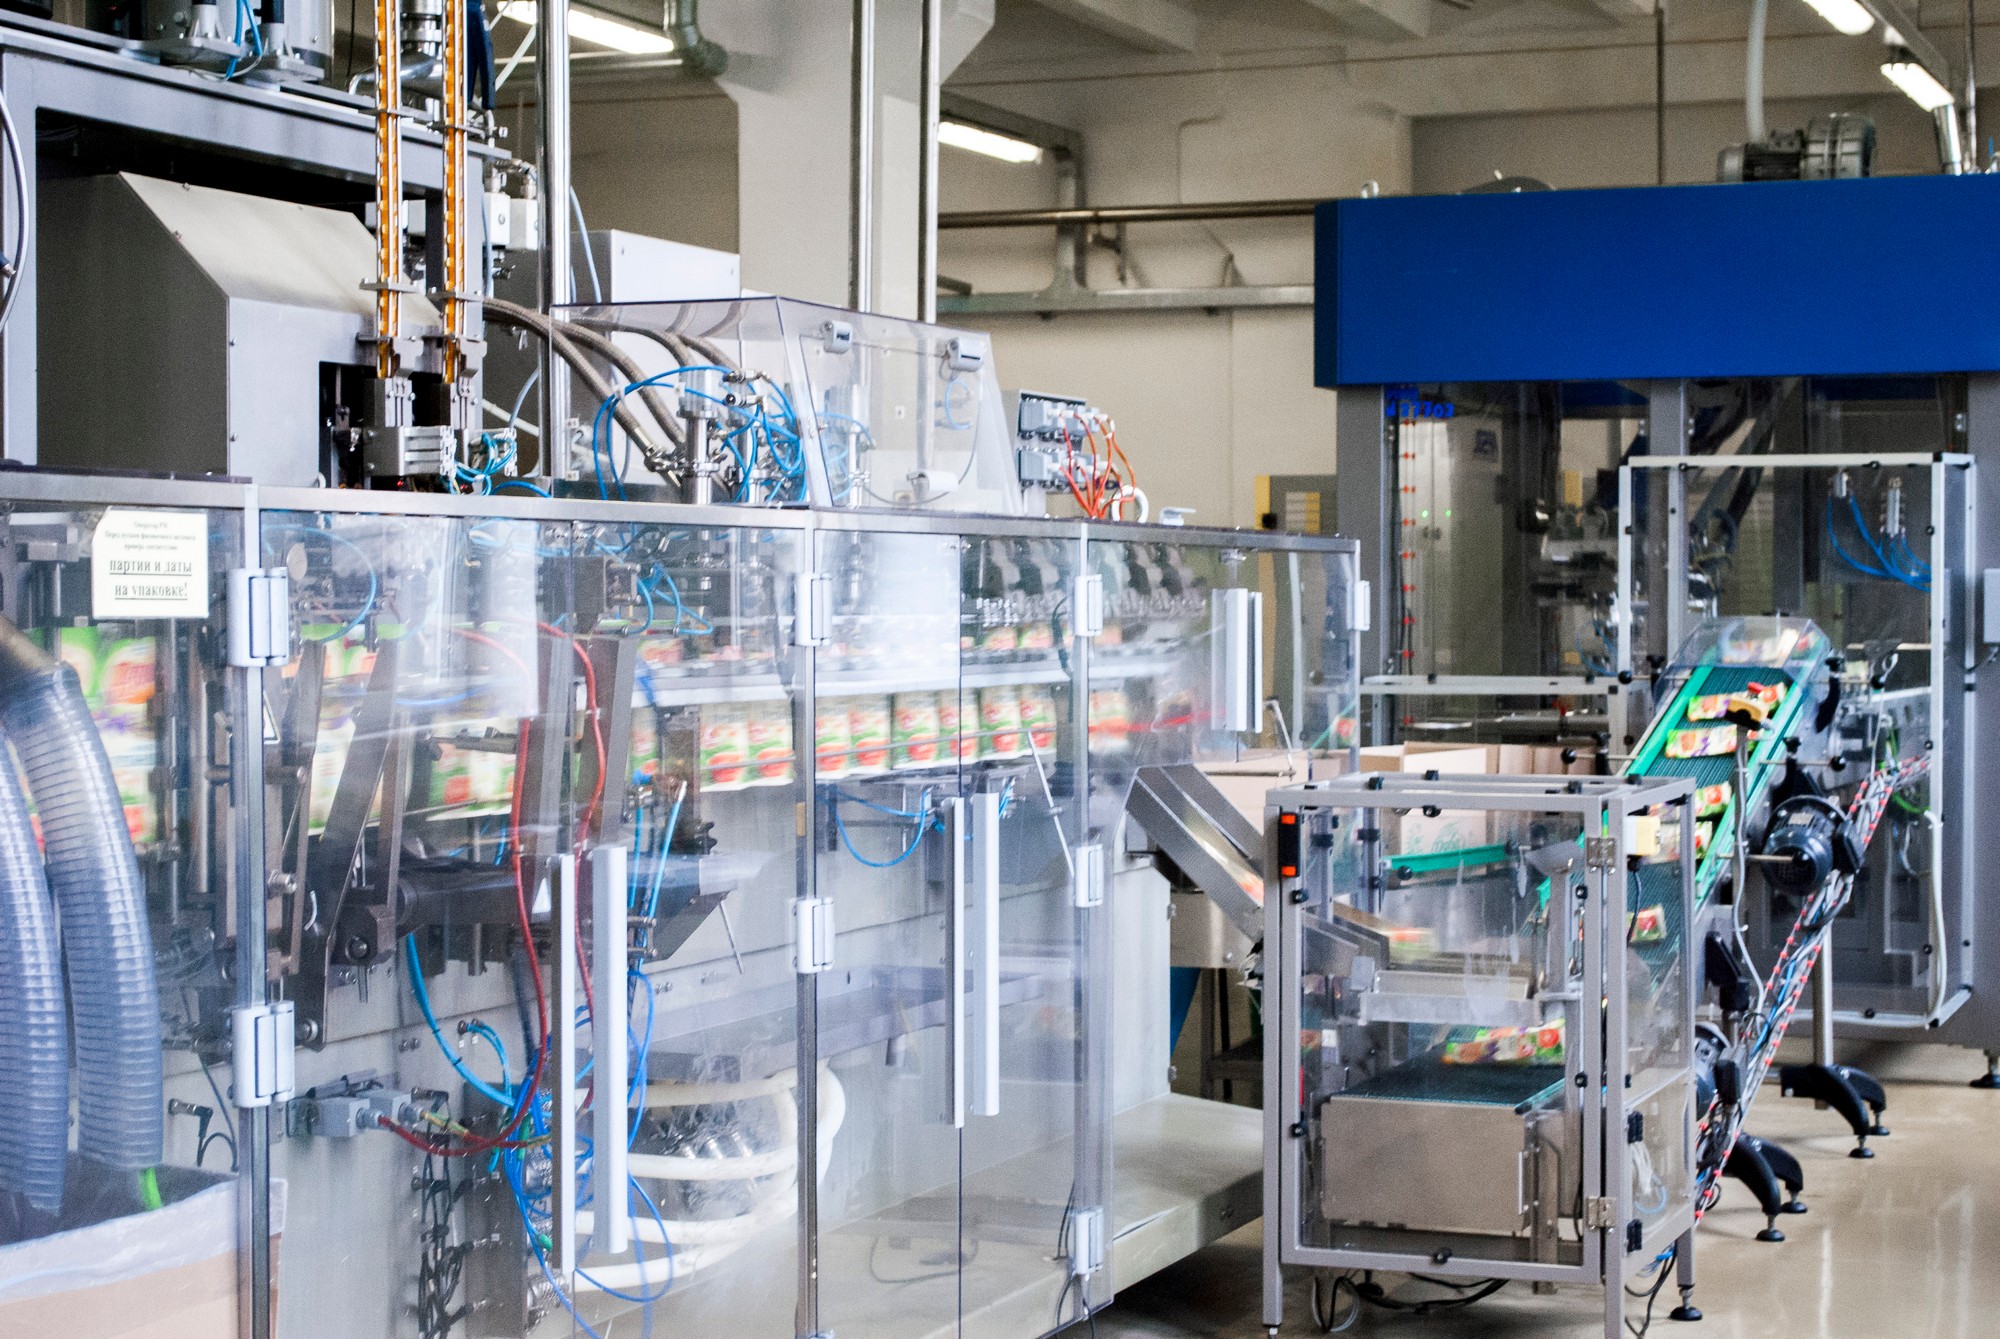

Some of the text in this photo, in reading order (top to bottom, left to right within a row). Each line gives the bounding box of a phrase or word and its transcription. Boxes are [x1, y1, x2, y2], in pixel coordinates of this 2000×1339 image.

[109, 560, 192, 575] партии и даты
[115, 582, 188, 598] на упаковке!
